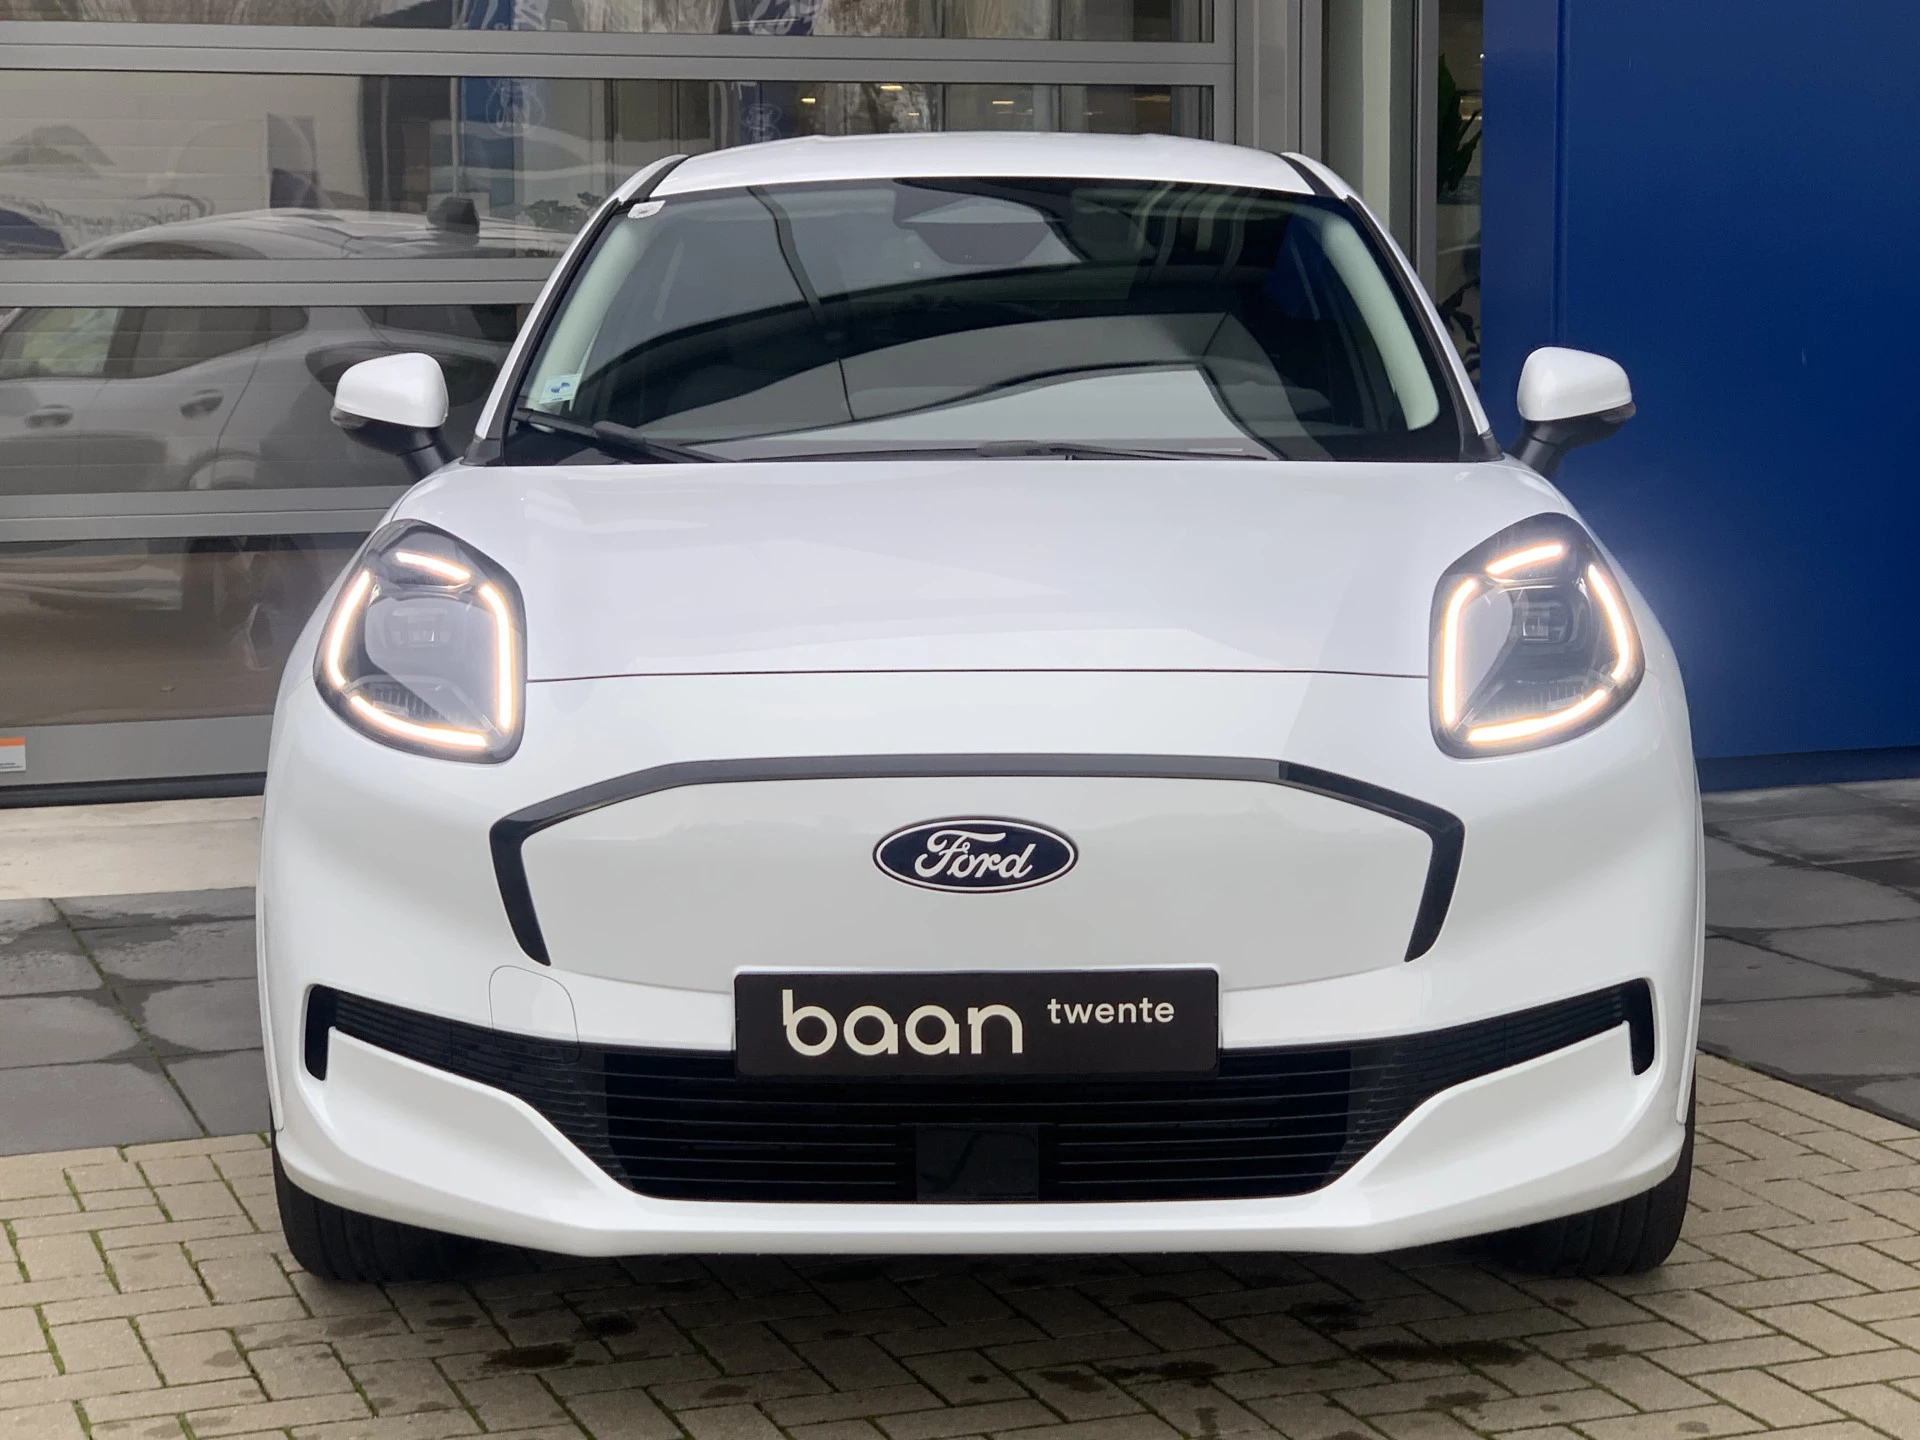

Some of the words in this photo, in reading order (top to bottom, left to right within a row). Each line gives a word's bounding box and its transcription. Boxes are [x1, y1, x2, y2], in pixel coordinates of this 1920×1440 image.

[914, 829, 1036, 879] Ford
[782, 989, 1023, 1057] baan
[1047, 997, 1175, 1024] twente
